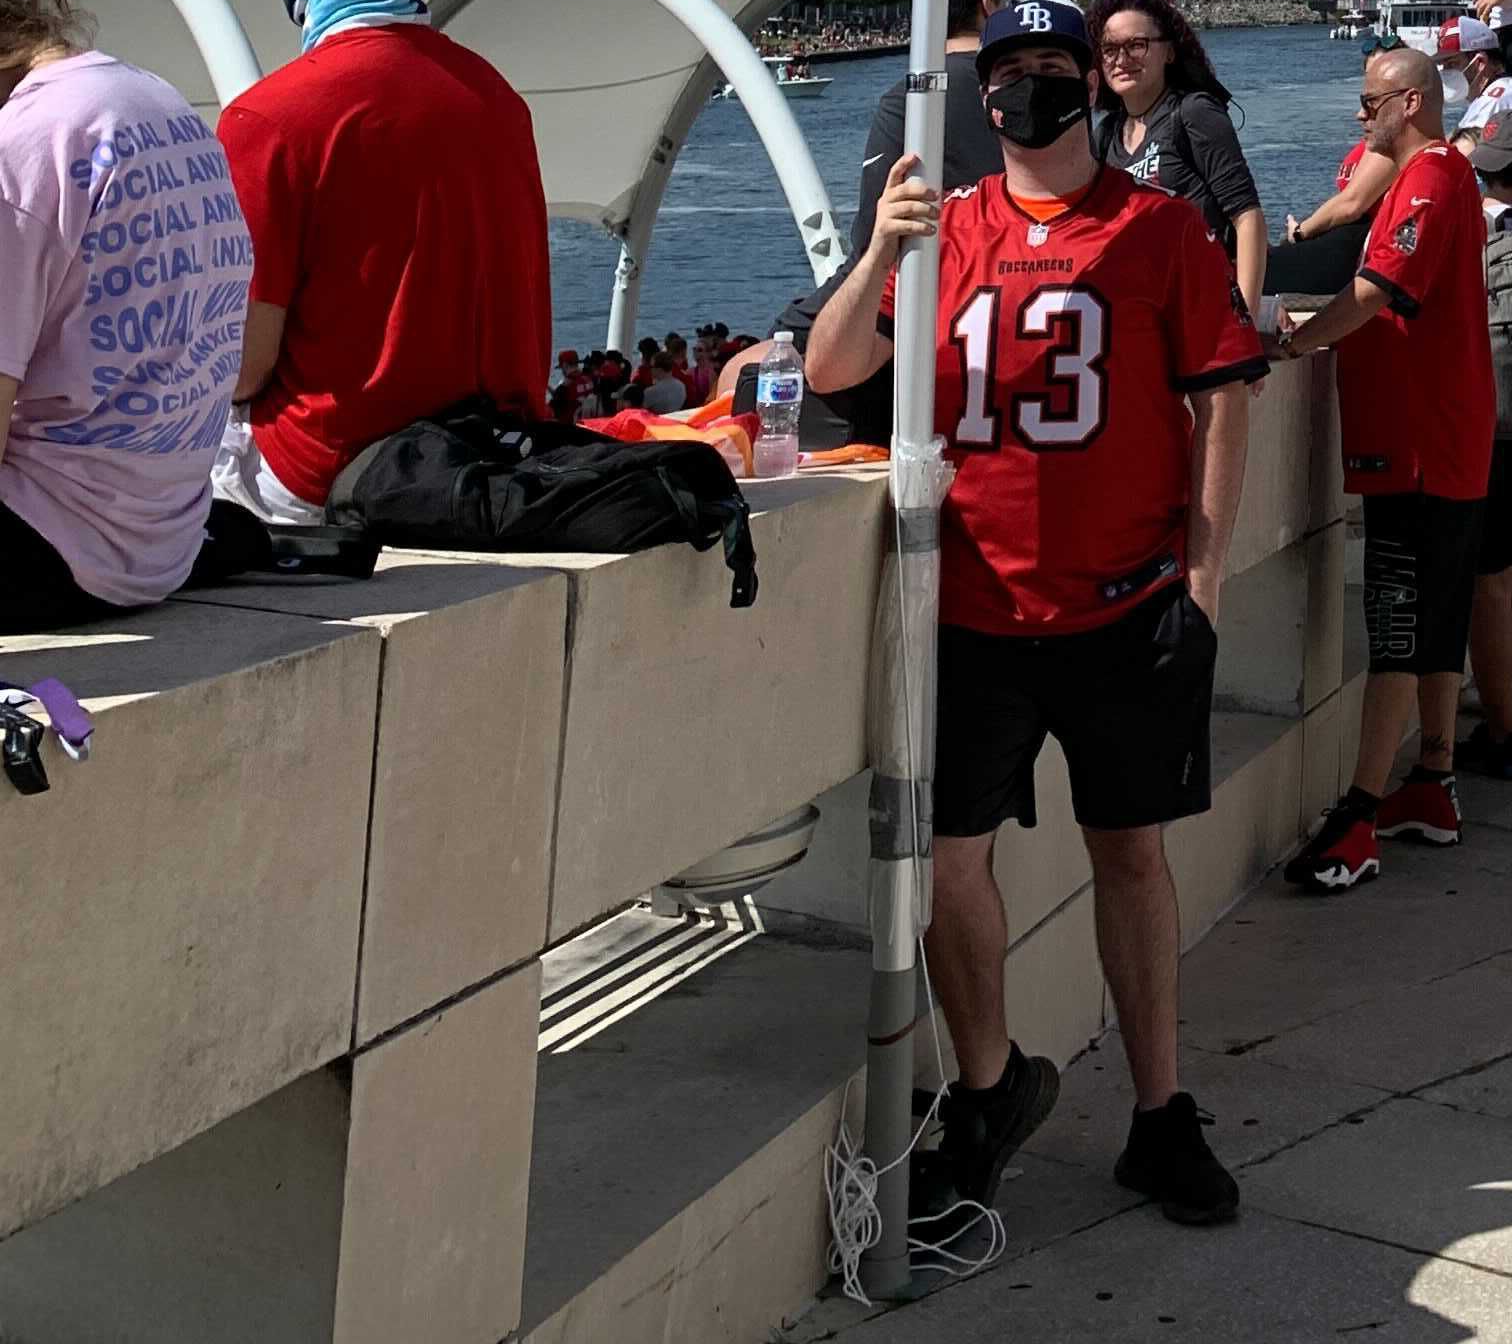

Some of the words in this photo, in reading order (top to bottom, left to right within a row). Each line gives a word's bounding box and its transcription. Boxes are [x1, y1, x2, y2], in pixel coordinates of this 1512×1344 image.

[1014, 2, 1053, 32] TB
[70, 119, 168, 190] SOCIAL
[97, 160, 185, 216] OCIAL
[81, 201, 198, 264] SOCIAL
[84, 243, 203, 308] SOCIAL
[997, 257, 1074, 275] BUCCANEERS
[89, 289, 200, 353] SOCIAL
[949, 283, 1111, 452] 13
